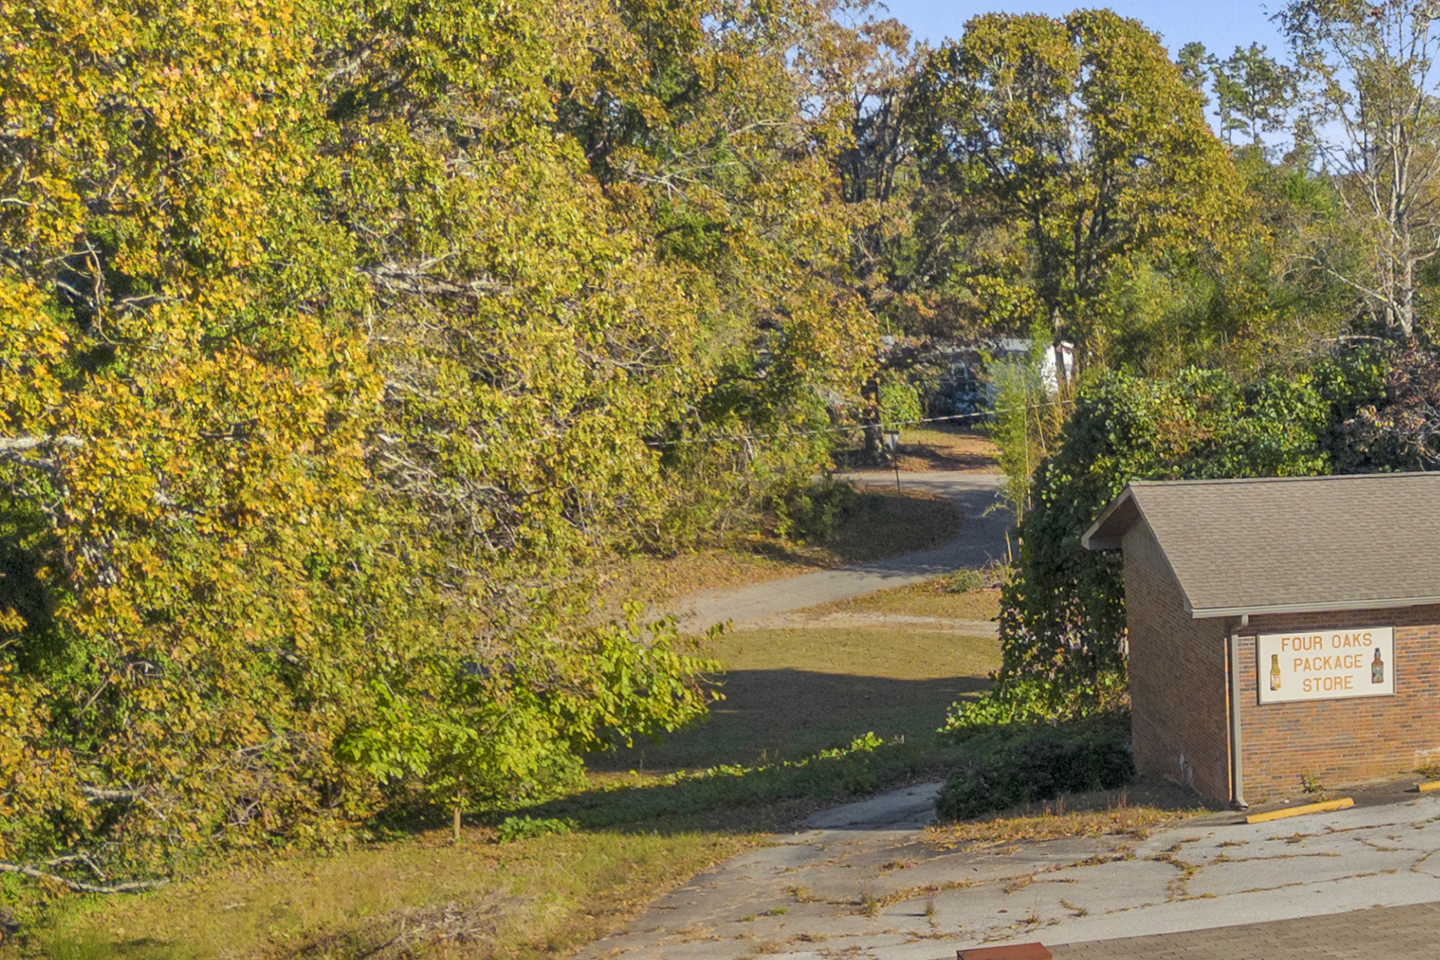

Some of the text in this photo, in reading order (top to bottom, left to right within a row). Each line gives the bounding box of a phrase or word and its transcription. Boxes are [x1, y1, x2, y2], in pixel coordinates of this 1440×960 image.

[1281, 633, 1373, 652] FOUR OAKS
[1293, 654, 1363, 672] PACKAGE
[1303, 676, 1354, 692] STORE
